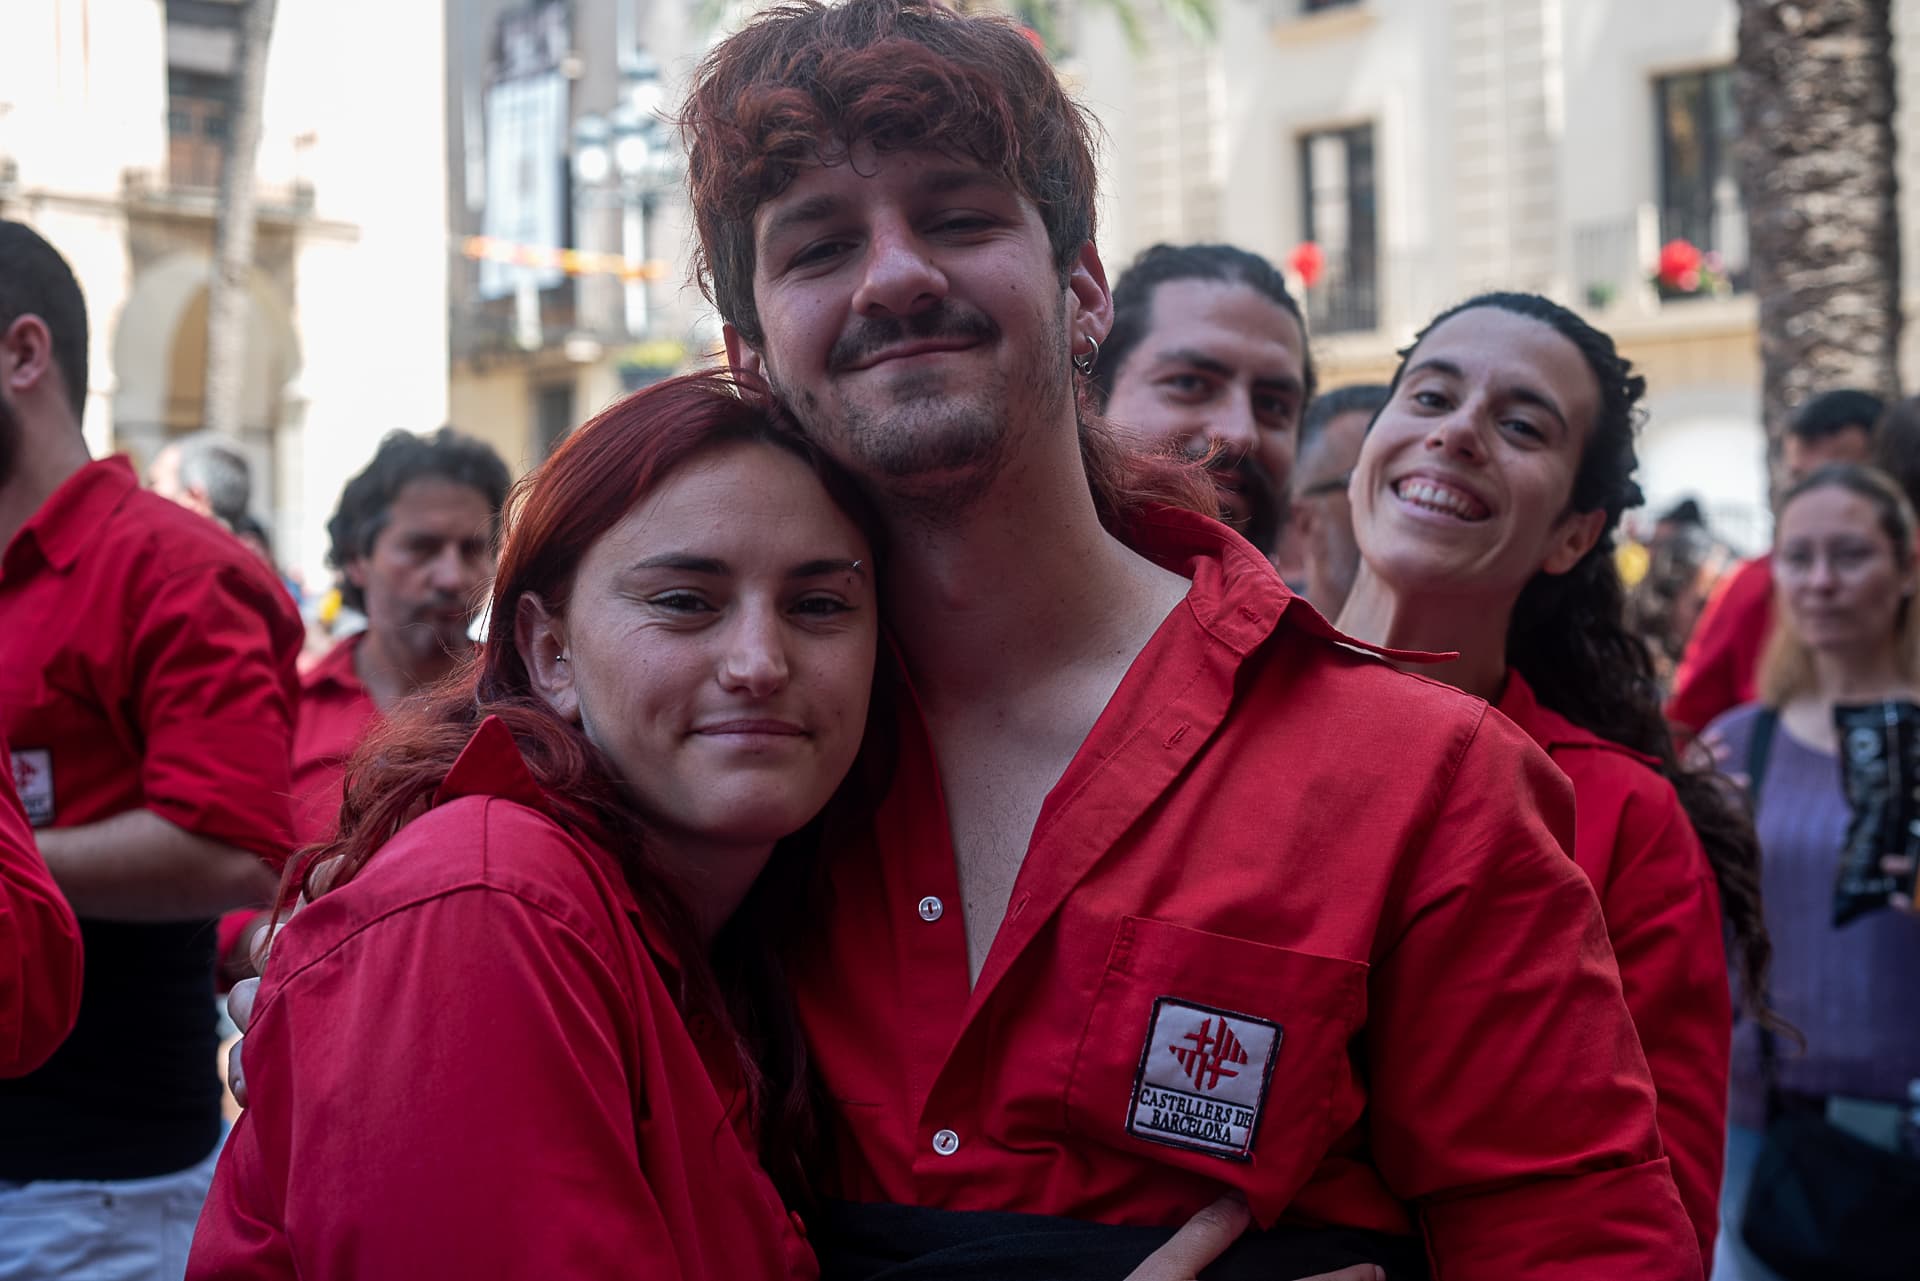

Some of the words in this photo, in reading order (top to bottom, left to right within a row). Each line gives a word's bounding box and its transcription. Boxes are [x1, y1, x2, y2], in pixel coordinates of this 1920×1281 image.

[1140, 1088, 1233, 1124] CASTELLERS
[1233, 1109, 1254, 1129] DE
[1151, 1109, 1231, 1142] BARCELONA
